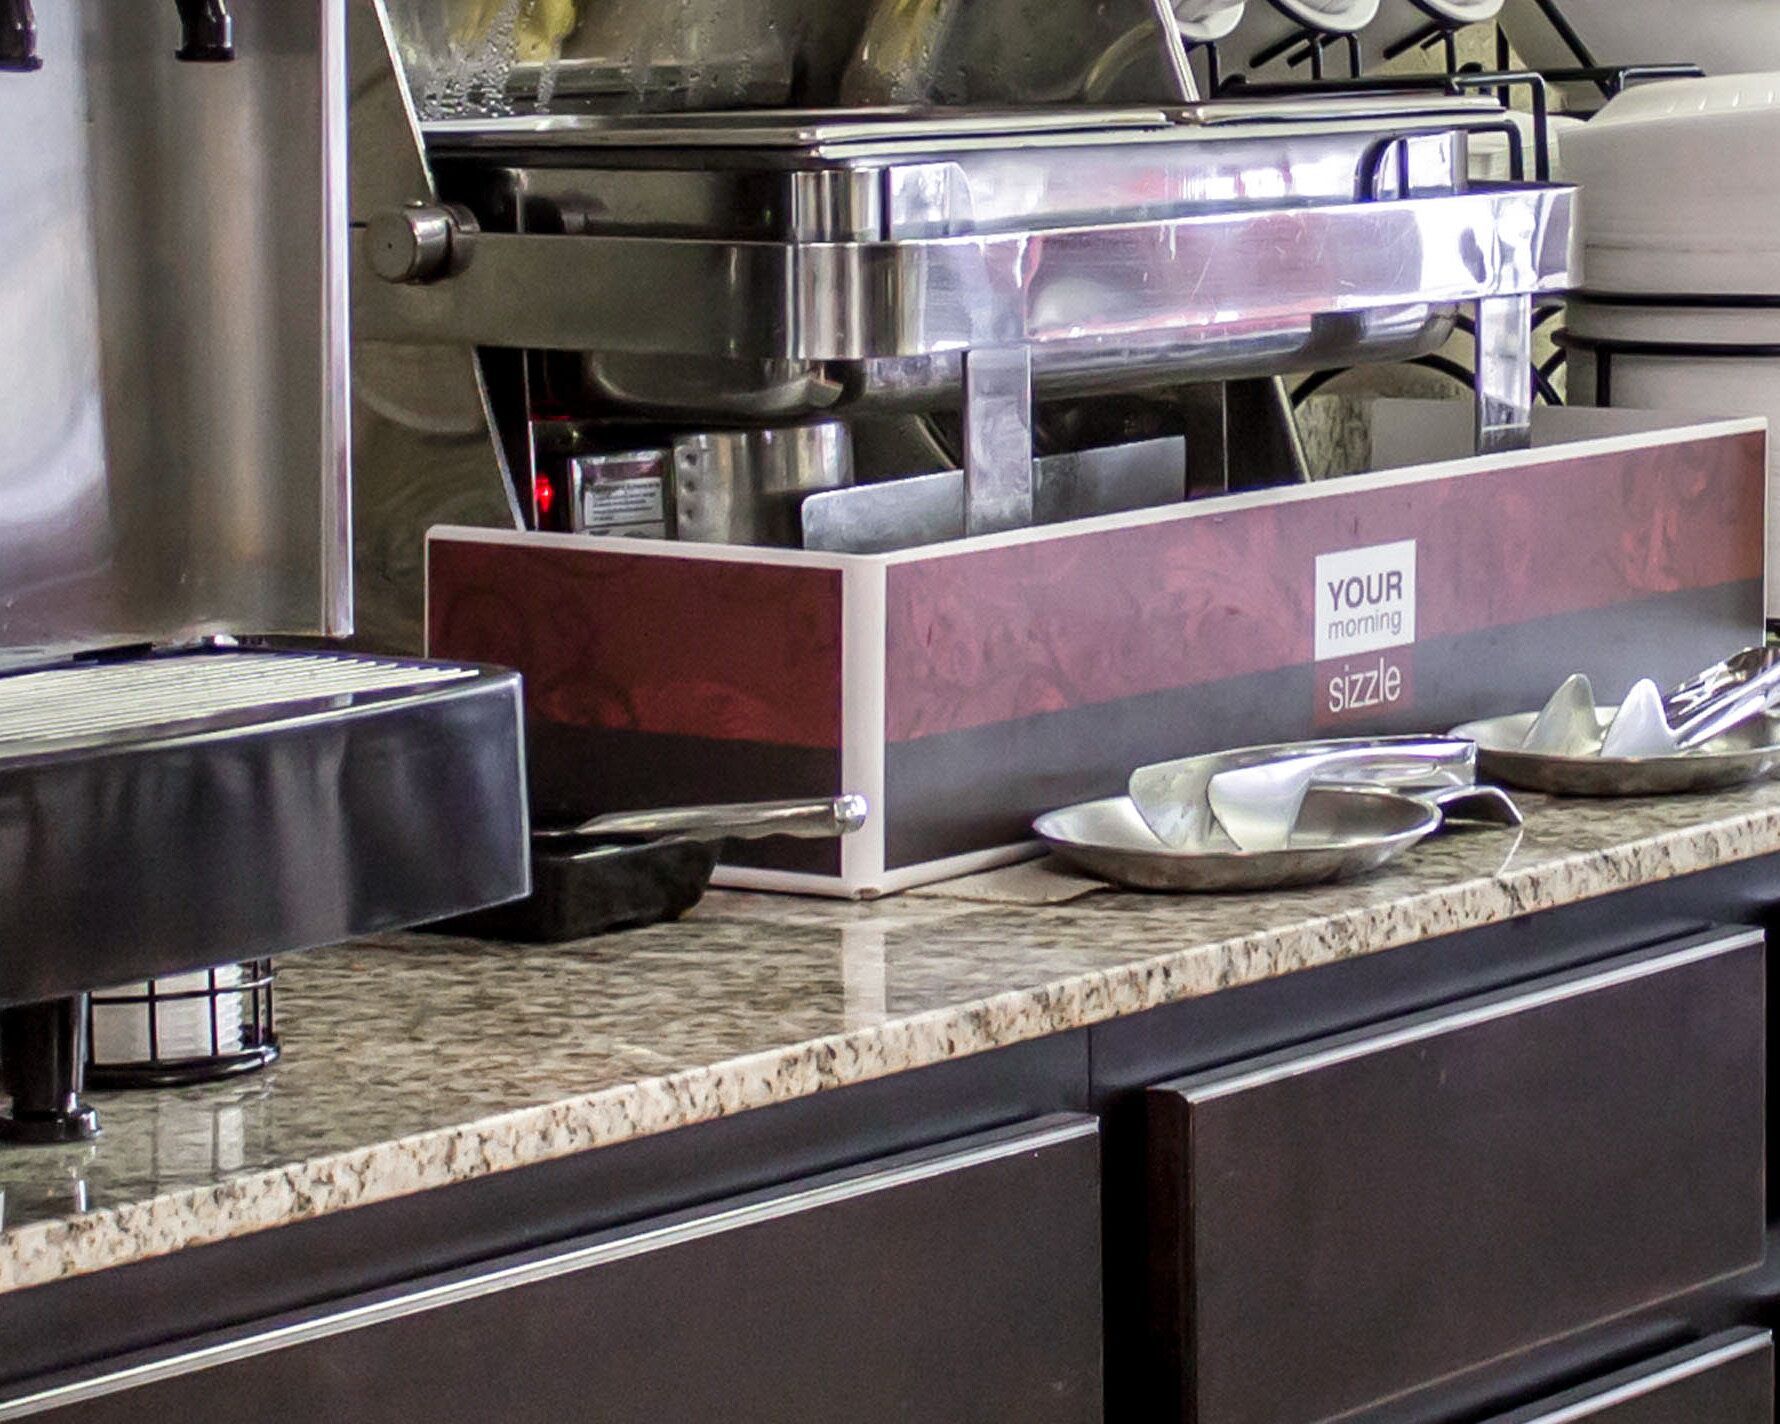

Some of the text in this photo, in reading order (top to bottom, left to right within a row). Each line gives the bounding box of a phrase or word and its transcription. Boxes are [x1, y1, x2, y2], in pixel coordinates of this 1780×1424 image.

[1328, 570, 1402, 611] YOUR
[1328, 609, 1402, 639] morning
[1329, 657, 1401, 712] sizzle
